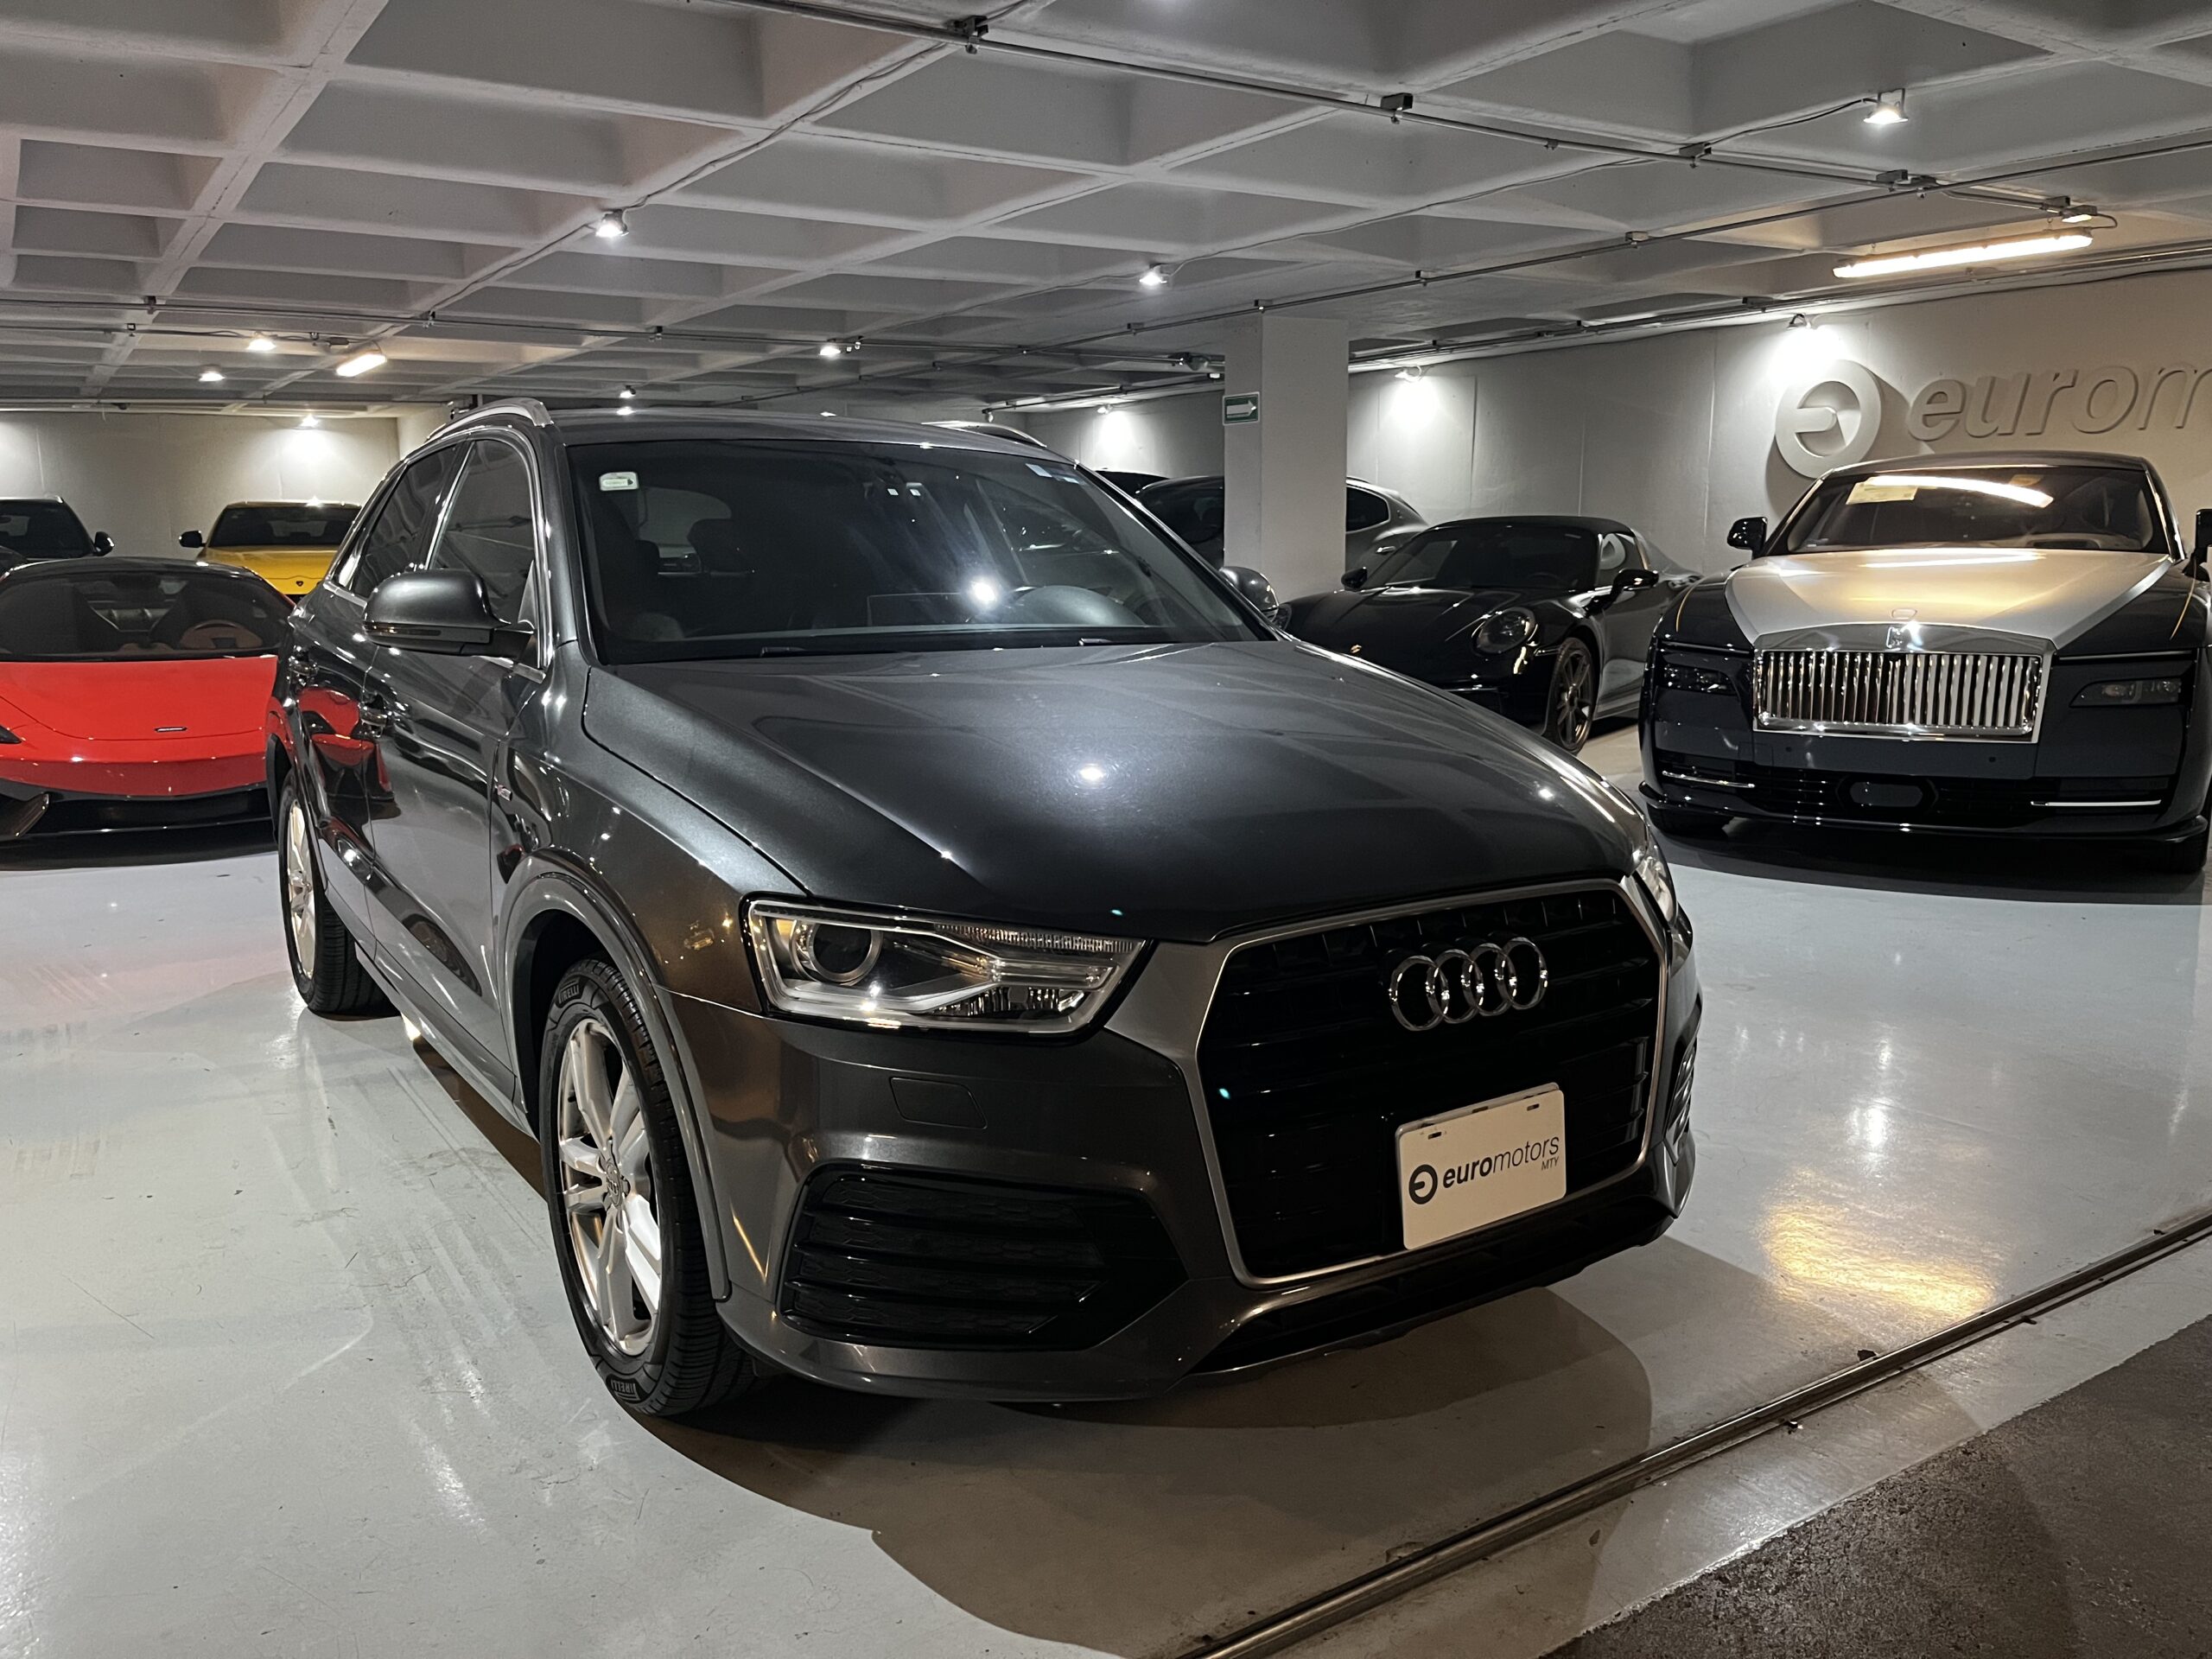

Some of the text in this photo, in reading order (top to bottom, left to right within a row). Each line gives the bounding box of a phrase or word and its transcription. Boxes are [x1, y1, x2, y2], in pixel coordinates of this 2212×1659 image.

[558, 978, 580, 1004] PIRELLI
[1442, 1136, 1560, 1189] euromotors
[1541, 1155, 1559, 1171] MTY
[610, 1379, 640, 1401] PIRELLI
